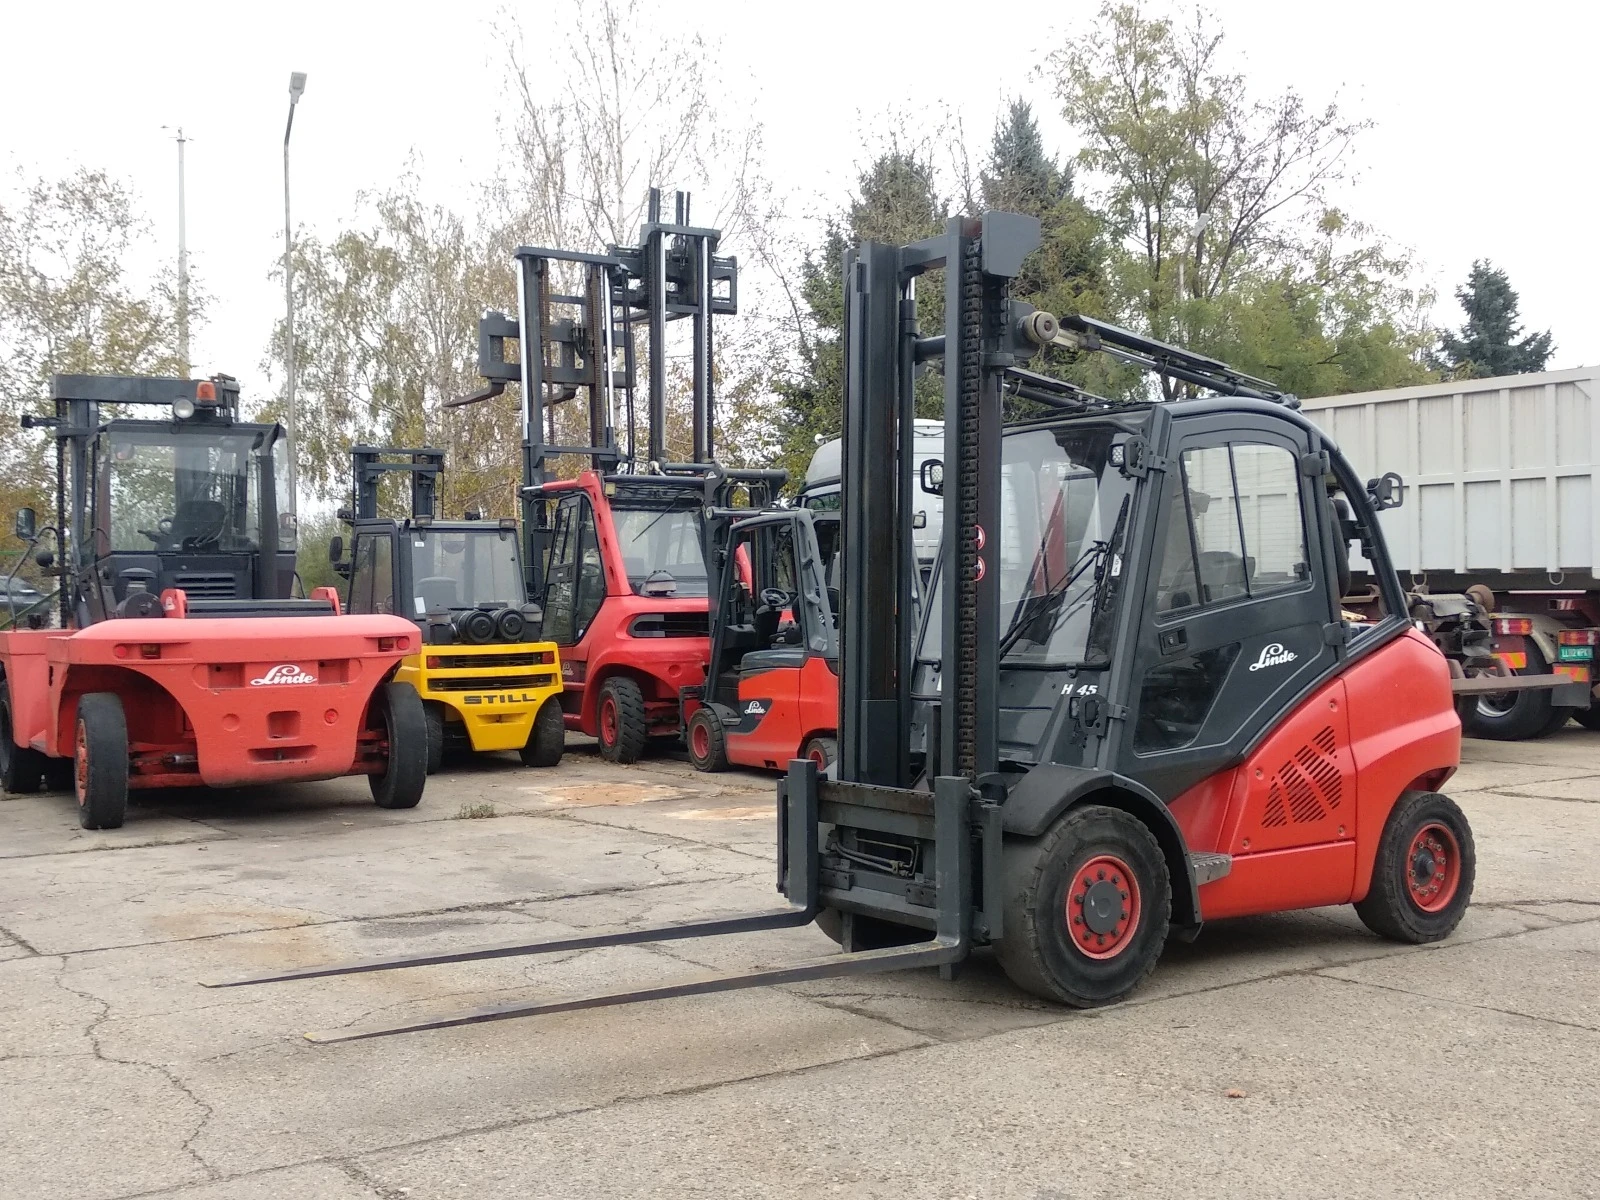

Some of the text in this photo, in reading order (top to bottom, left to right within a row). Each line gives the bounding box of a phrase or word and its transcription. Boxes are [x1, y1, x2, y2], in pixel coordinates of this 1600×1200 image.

[1248, 642, 1299, 672] Linde
[249, 663, 319, 686] Linde
[1060, 683, 1099, 696] H 45
[463, 693, 537, 705] STILL
[744, 700, 767, 715] Linde
